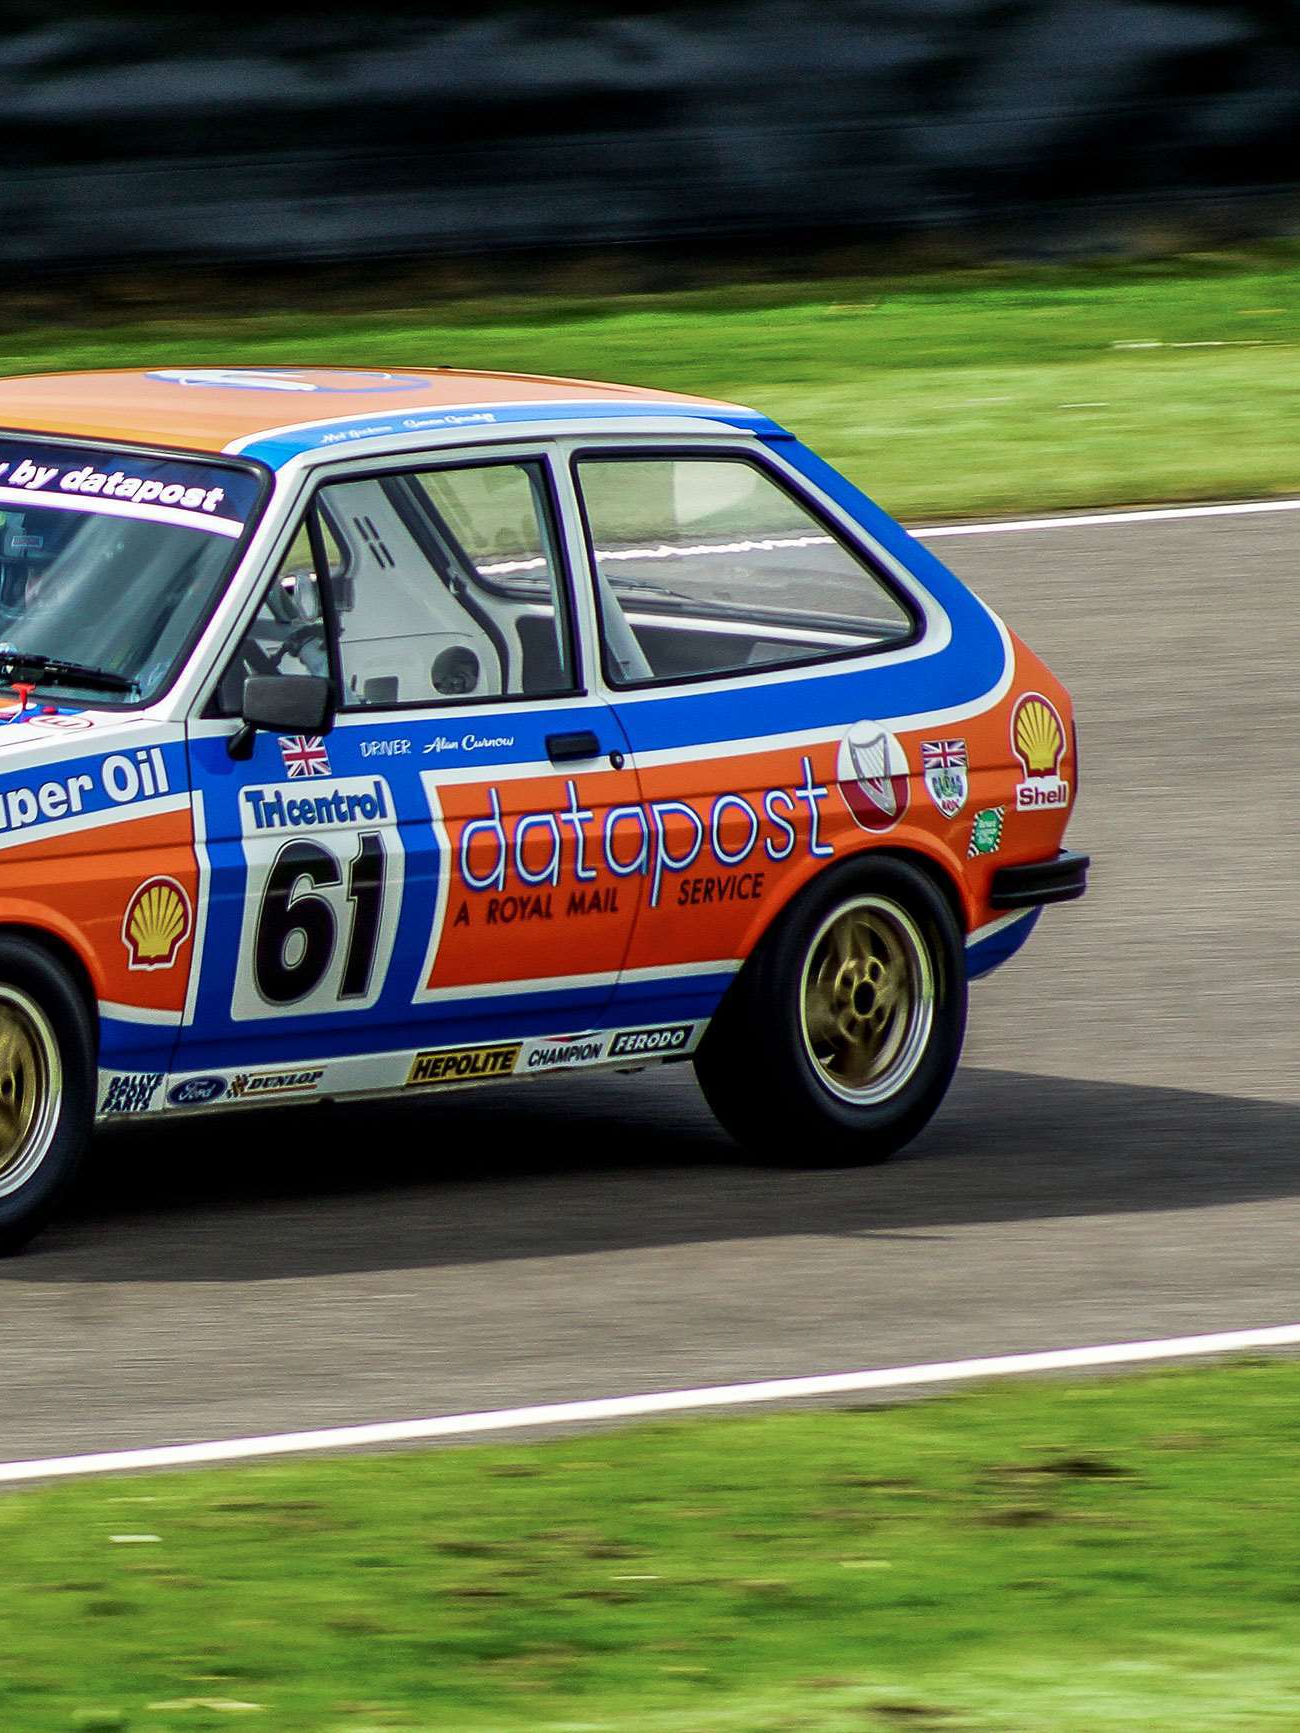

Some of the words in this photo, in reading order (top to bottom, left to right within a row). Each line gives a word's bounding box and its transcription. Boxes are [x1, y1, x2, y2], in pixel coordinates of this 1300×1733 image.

[8, 459, 58, 489] by
[59, 467, 225, 512] datapost
[360, 739, 411, 757] DRIVER
[101, 747, 170, 803] Oil
[245, 780, 388, 830] Tricentrol
[1019, 784, 1067, 807] Shell
[459, 756, 835, 908] datapost
[453, 901, 471, 928] A
[487, 894, 553, 924] ROYAL
[567, 887, 619, 916] MAIL
[678, 873, 765, 906] SERVICE
[254, 830, 388, 1007] 61
[614, 1029, 686, 1053] FERODO
[413, 1050, 517, 1081] HEPOLITE
[528, 1043, 603, 1067] CHAMPION
[107, 1085, 157, 1101] SPORT
[178, 1080, 217, 1101] Ford
[248, 1071, 324, 1091] DUNLOP
[102, 1097, 152, 1113] PARTS
